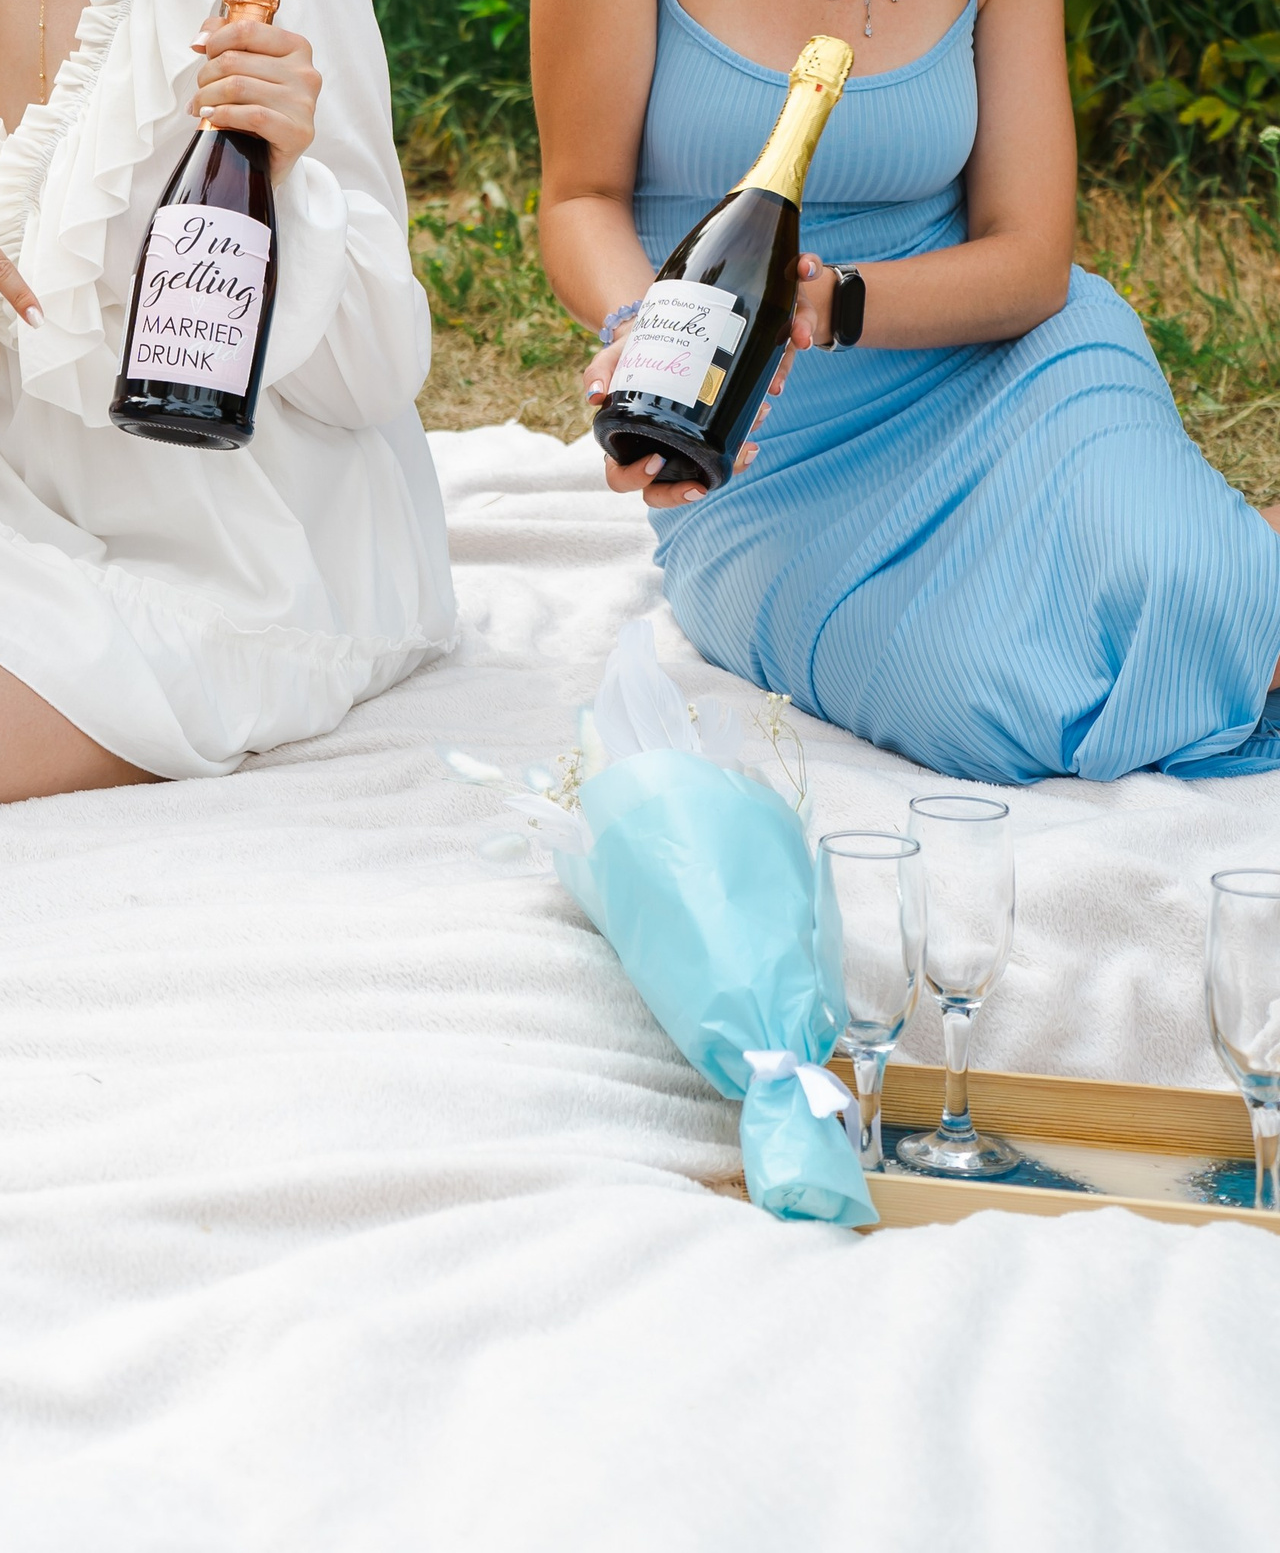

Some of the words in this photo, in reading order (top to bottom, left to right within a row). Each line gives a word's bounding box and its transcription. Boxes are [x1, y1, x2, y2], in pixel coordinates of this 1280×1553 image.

[175, 217, 246, 258] I'm
[143, 260, 257, 320] getting
[671, 298, 695, 310] было
[697, 306, 711, 314] на
[142, 314, 243, 347] MARRIED
[633, 333, 675, 344] останется
[676, 338, 690, 347] на
[137, 343, 215, 372] DRUNK
